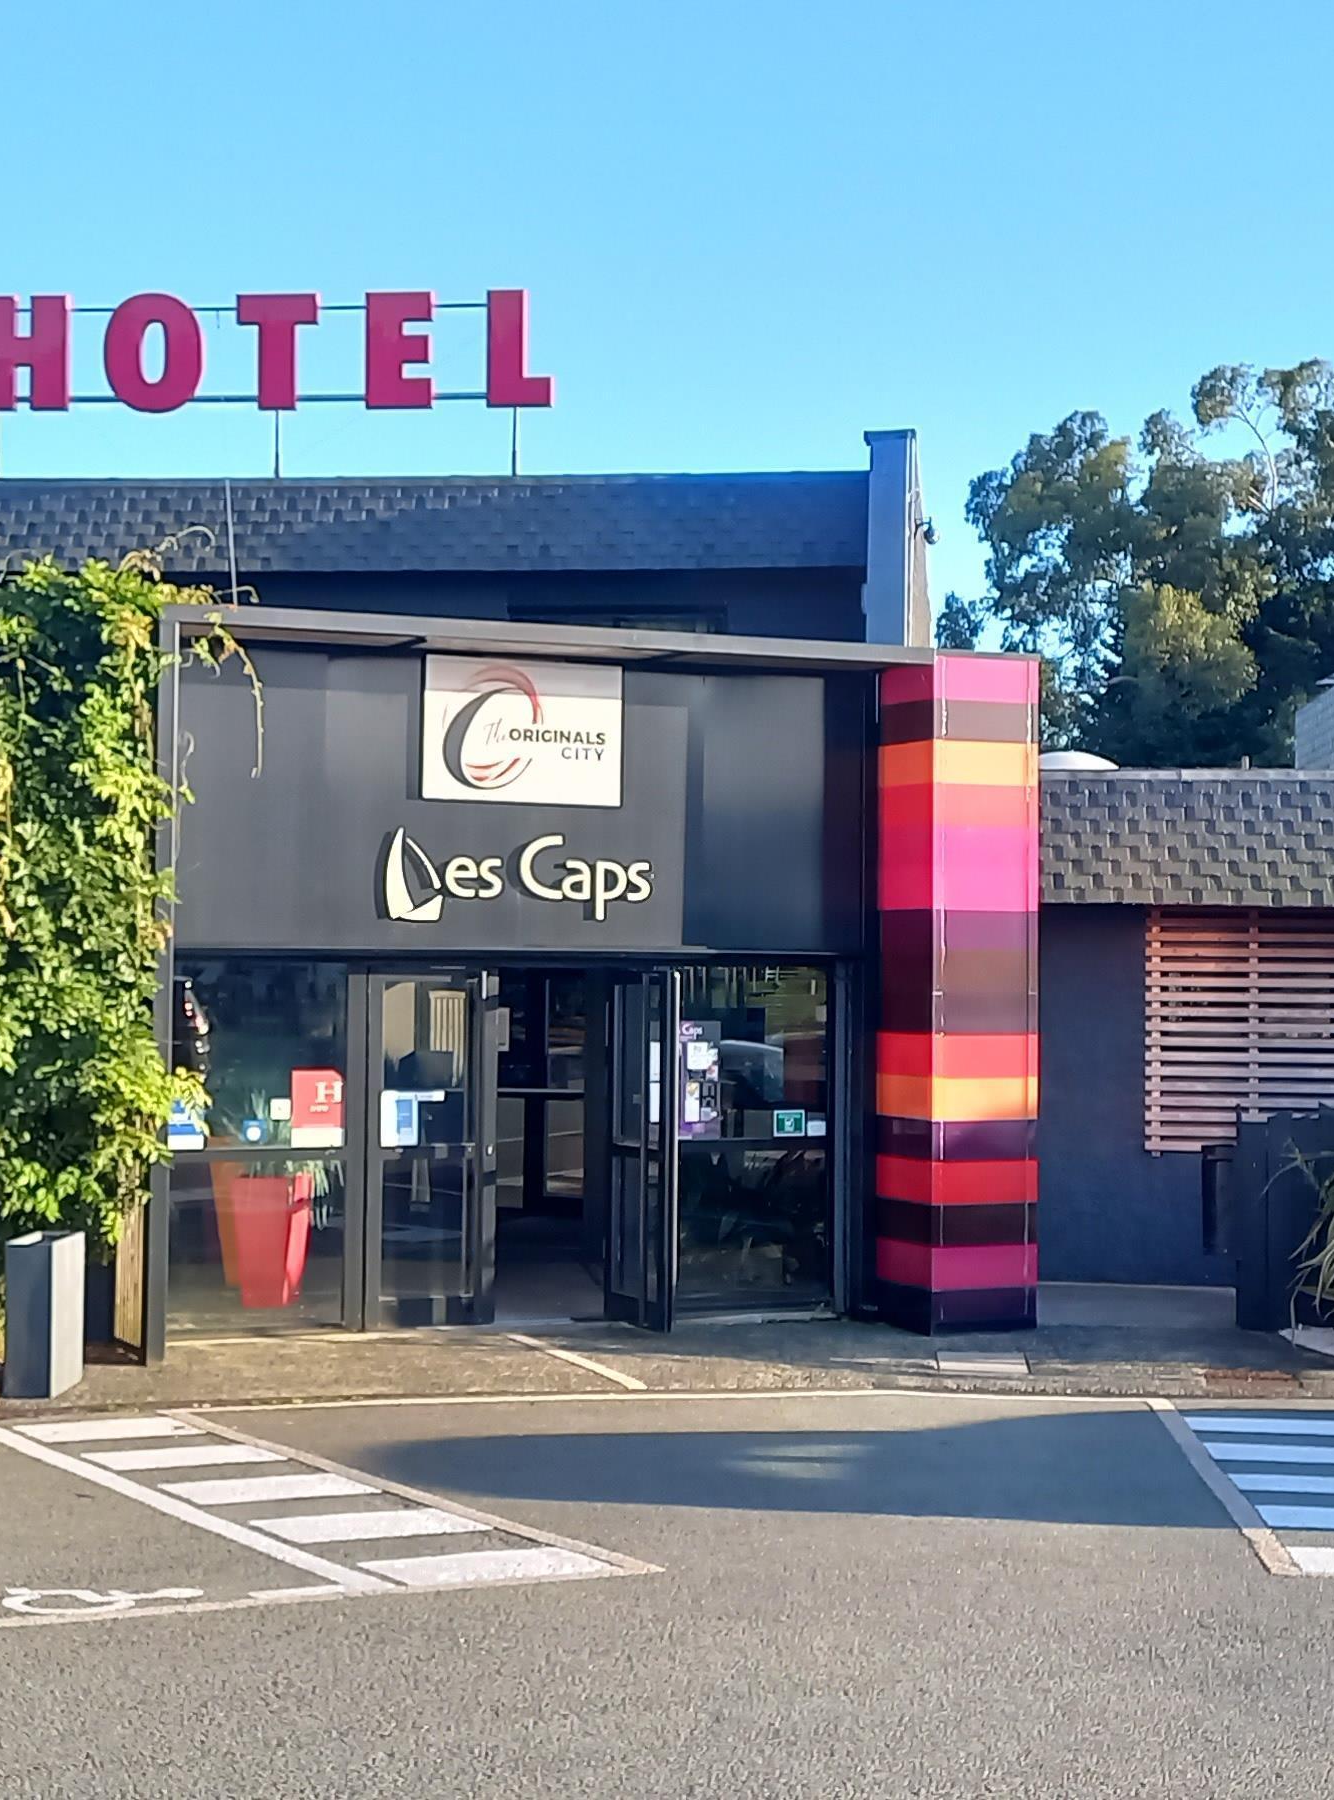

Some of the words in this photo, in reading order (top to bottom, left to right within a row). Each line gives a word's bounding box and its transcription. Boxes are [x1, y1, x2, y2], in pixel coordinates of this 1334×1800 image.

[508, 728, 606, 745] ORIGINALS
[561, 746, 604, 762] CITY
[519, 834, 653, 922] Caps
